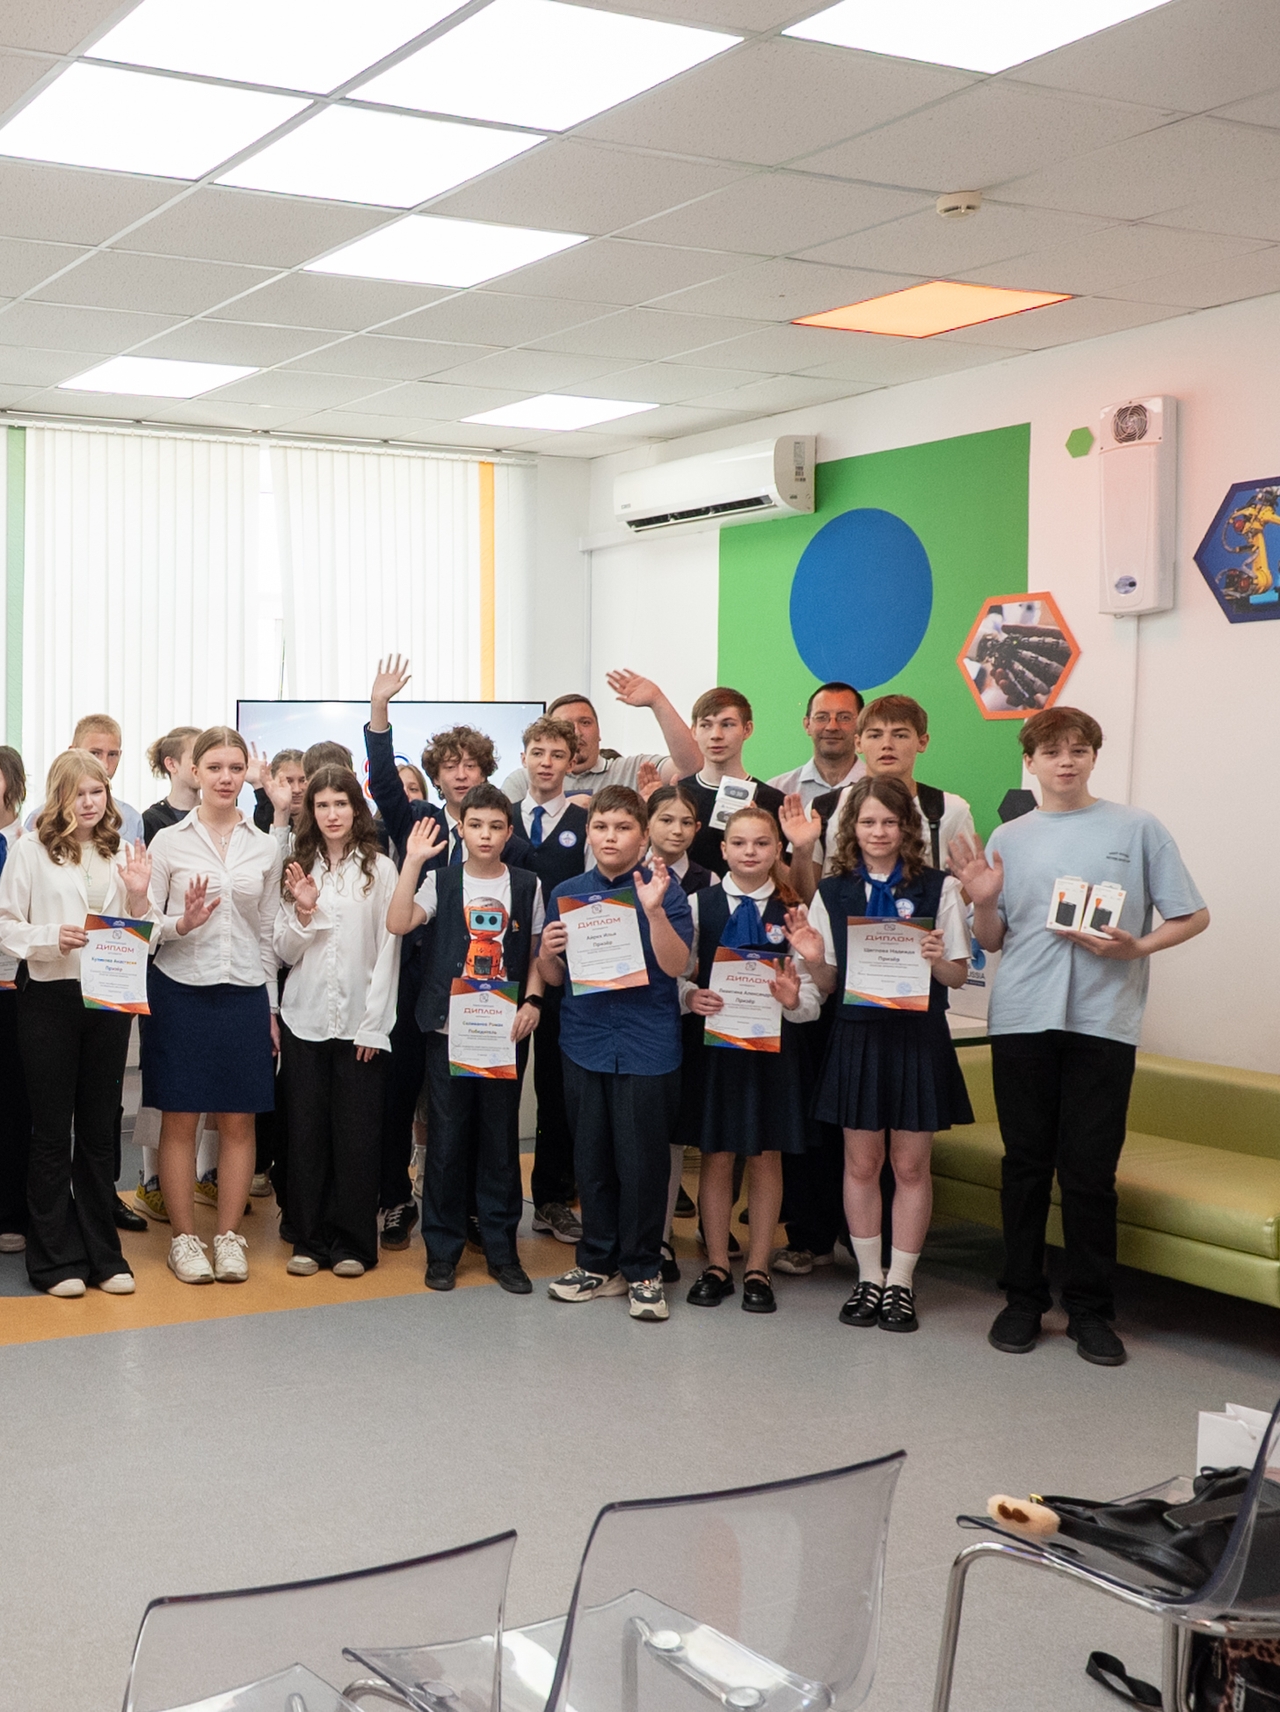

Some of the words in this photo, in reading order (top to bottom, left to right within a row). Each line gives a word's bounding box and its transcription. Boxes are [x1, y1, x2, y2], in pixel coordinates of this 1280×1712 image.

[577, 917, 621, 929] ДИПЛОМ
[865, 934, 914, 942] ДИПЛОМ
[95, 943, 135, 953] ДИПЛОМ
[593, 940, 613, 948] Призёр
[105, 965, 123, 973] Призёр
[726, 974, 770, 984] ДИПЛОМ
[967, 971, 986, 980] USSIA
[463, 1007, 503, 1015] ДИПЛОМ
